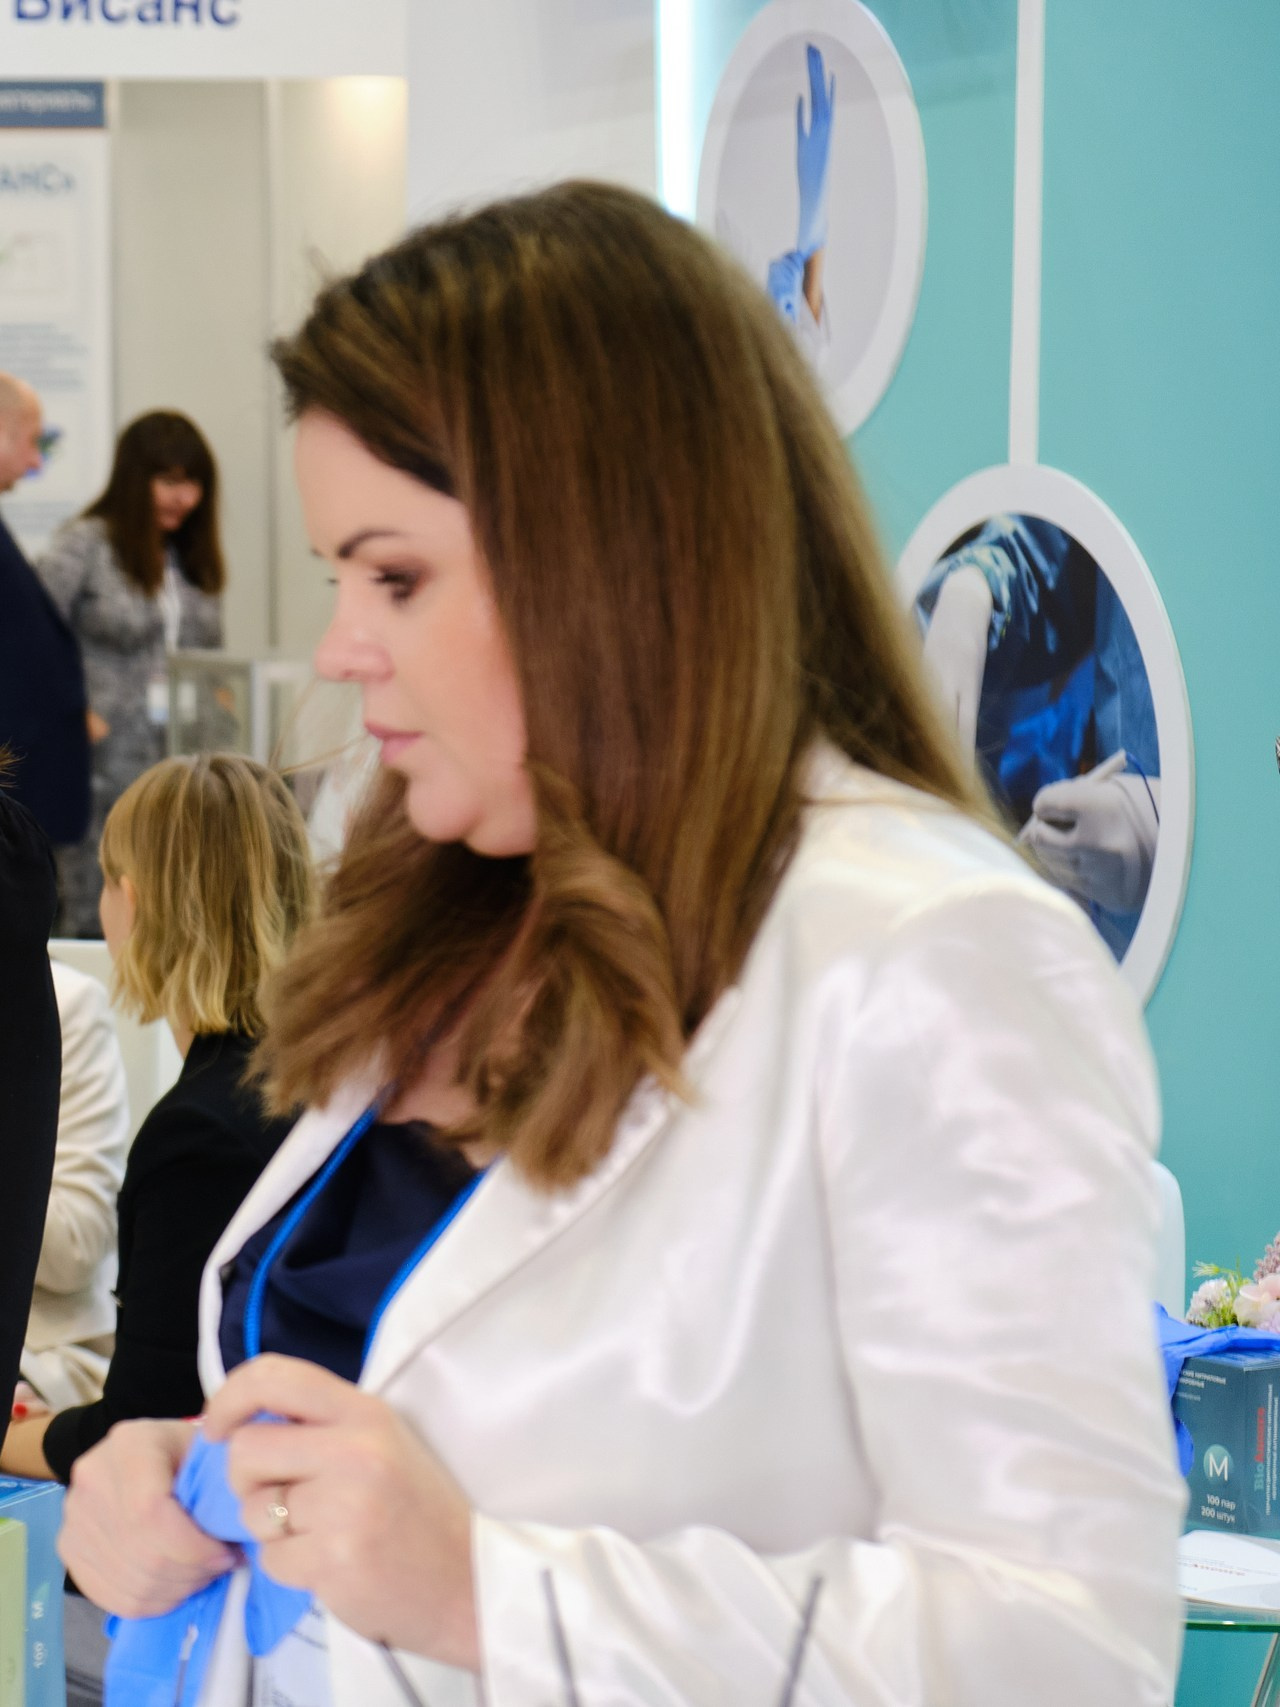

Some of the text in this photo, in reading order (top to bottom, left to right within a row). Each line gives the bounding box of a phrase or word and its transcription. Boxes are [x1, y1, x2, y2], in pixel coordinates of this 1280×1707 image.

[1209, 1453, 1228, 1482] M
[1207, 1494, 1236, 1511] 100 пар
[1201, 1506, 1236, 1524] 200 штук
